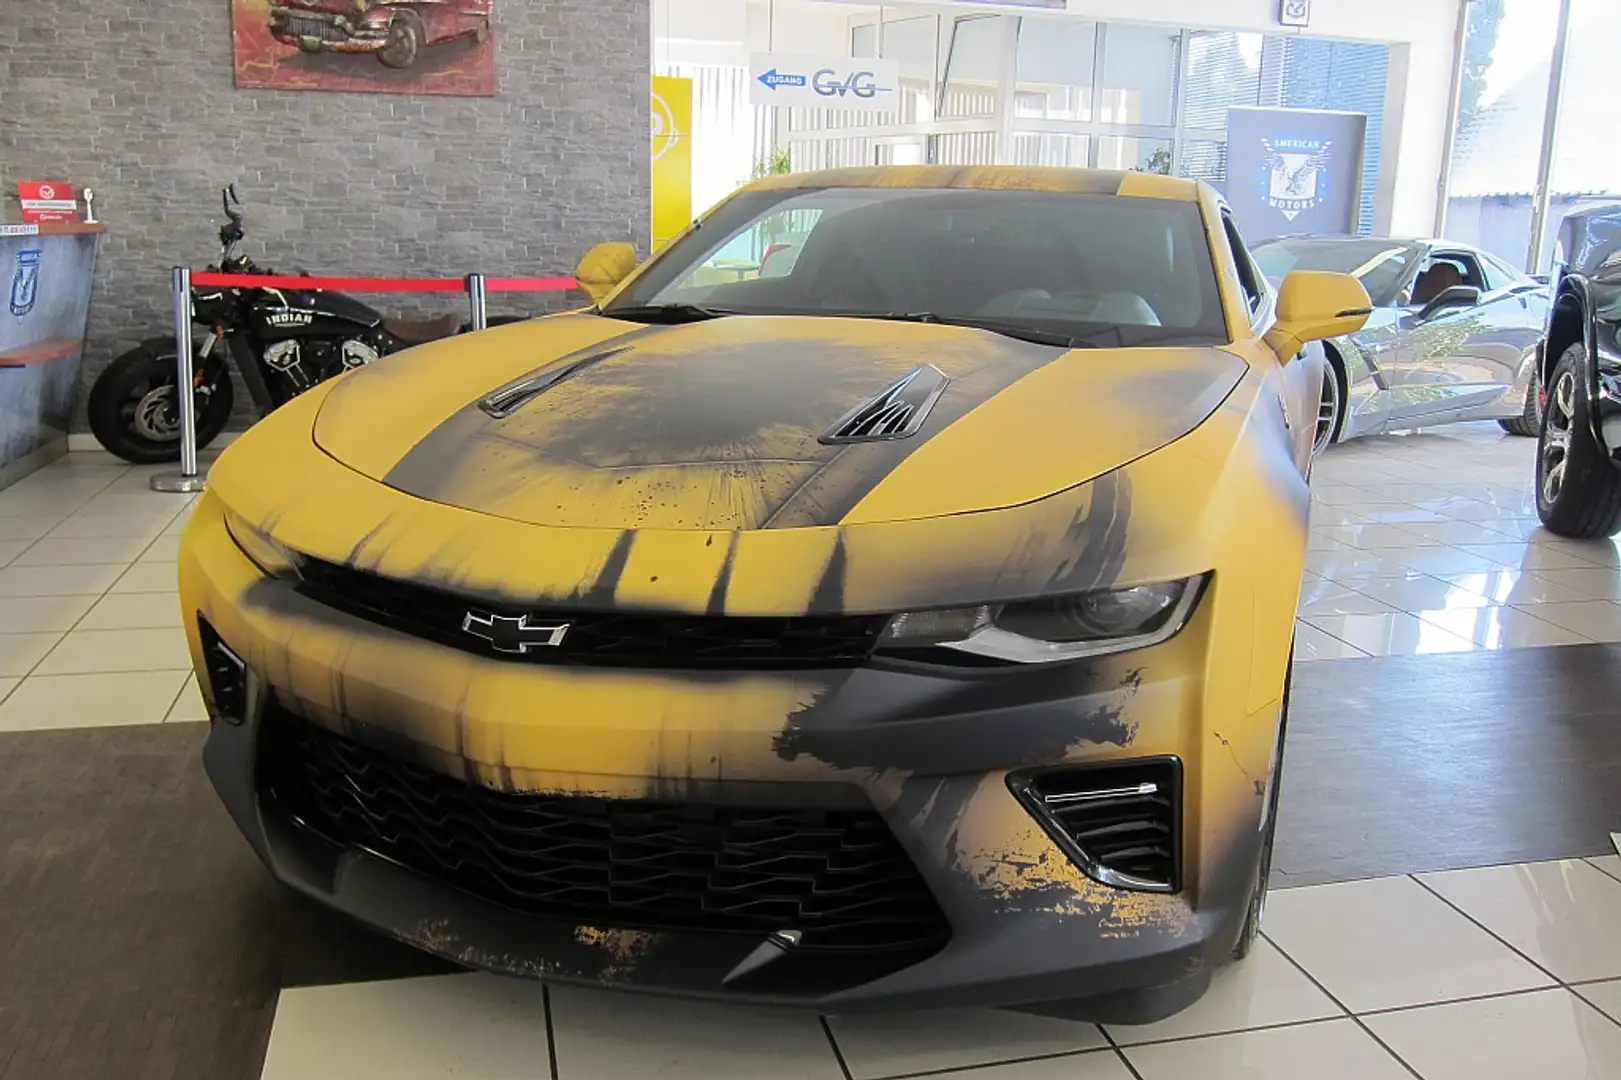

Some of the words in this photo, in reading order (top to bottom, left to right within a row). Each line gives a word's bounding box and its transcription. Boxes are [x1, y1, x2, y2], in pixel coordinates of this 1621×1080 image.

[766, 75, 803, 85] ZUGANG
[1274, 139, 1321, 149] AMERICAN
[1268, 198, 1315, 210] MOTORS
[265, 313, 313, 325] INDIAN
